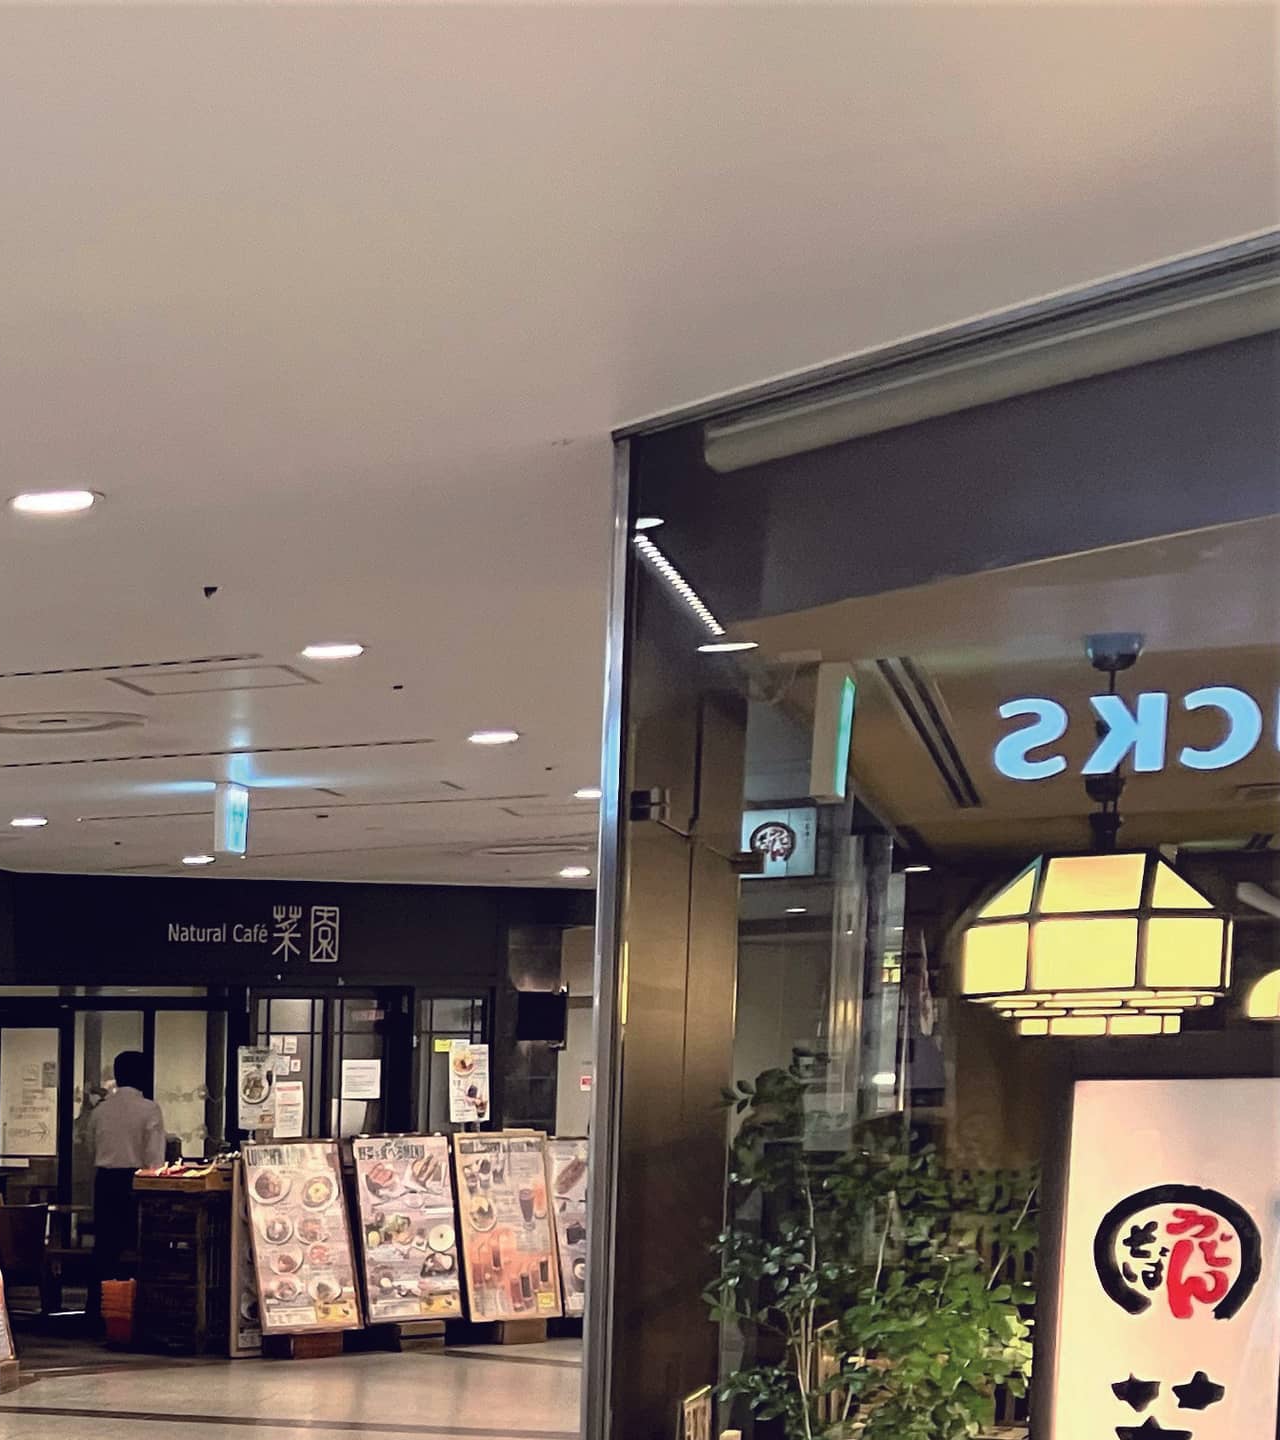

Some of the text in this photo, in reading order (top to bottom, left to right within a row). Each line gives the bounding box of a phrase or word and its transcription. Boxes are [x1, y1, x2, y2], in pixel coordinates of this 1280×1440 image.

[167, 904, 340, 962] Natural Café 菜園
